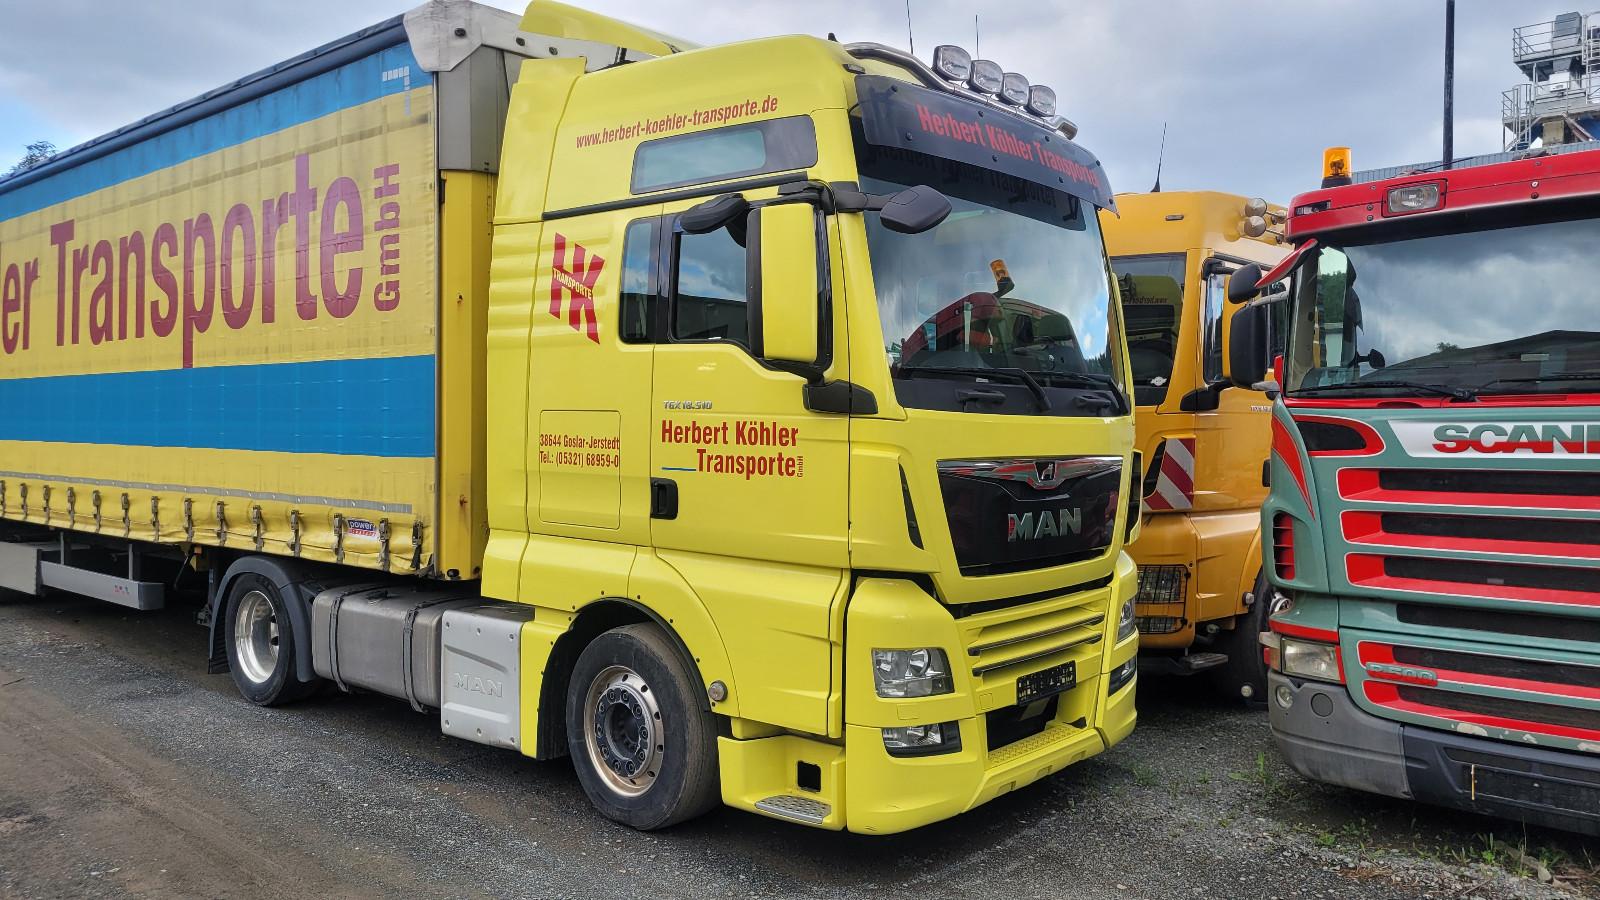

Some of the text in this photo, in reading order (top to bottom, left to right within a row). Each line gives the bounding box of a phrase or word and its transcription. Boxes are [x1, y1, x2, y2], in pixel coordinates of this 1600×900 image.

[576, 95, 778, 149] www.herbert-koehler-transporte.de
[916, 103, 986, 147] Herbert
[985, 123, 1033, 161] Köhler
[373, 163, 400, 312] GmbH
[50, 152, 364, 369] Transporte
[549, 232, 605, 345] HK
[552, 267, 592, 300] TRANSPORTE
[663, 400, 713, 410] TGX 18.510
[540, 433, 620, 450] 38644 Goslar-Jerstedt
[661, 419, 799, 447] Herbert Köhler
[540, 450, 619, 468] Tel.: (05321) 68959-0
[697, 448, 796, 480] Transporte
[1008, 507, 1082, 543] MAN
[453, 672, 504, 699] MAN
